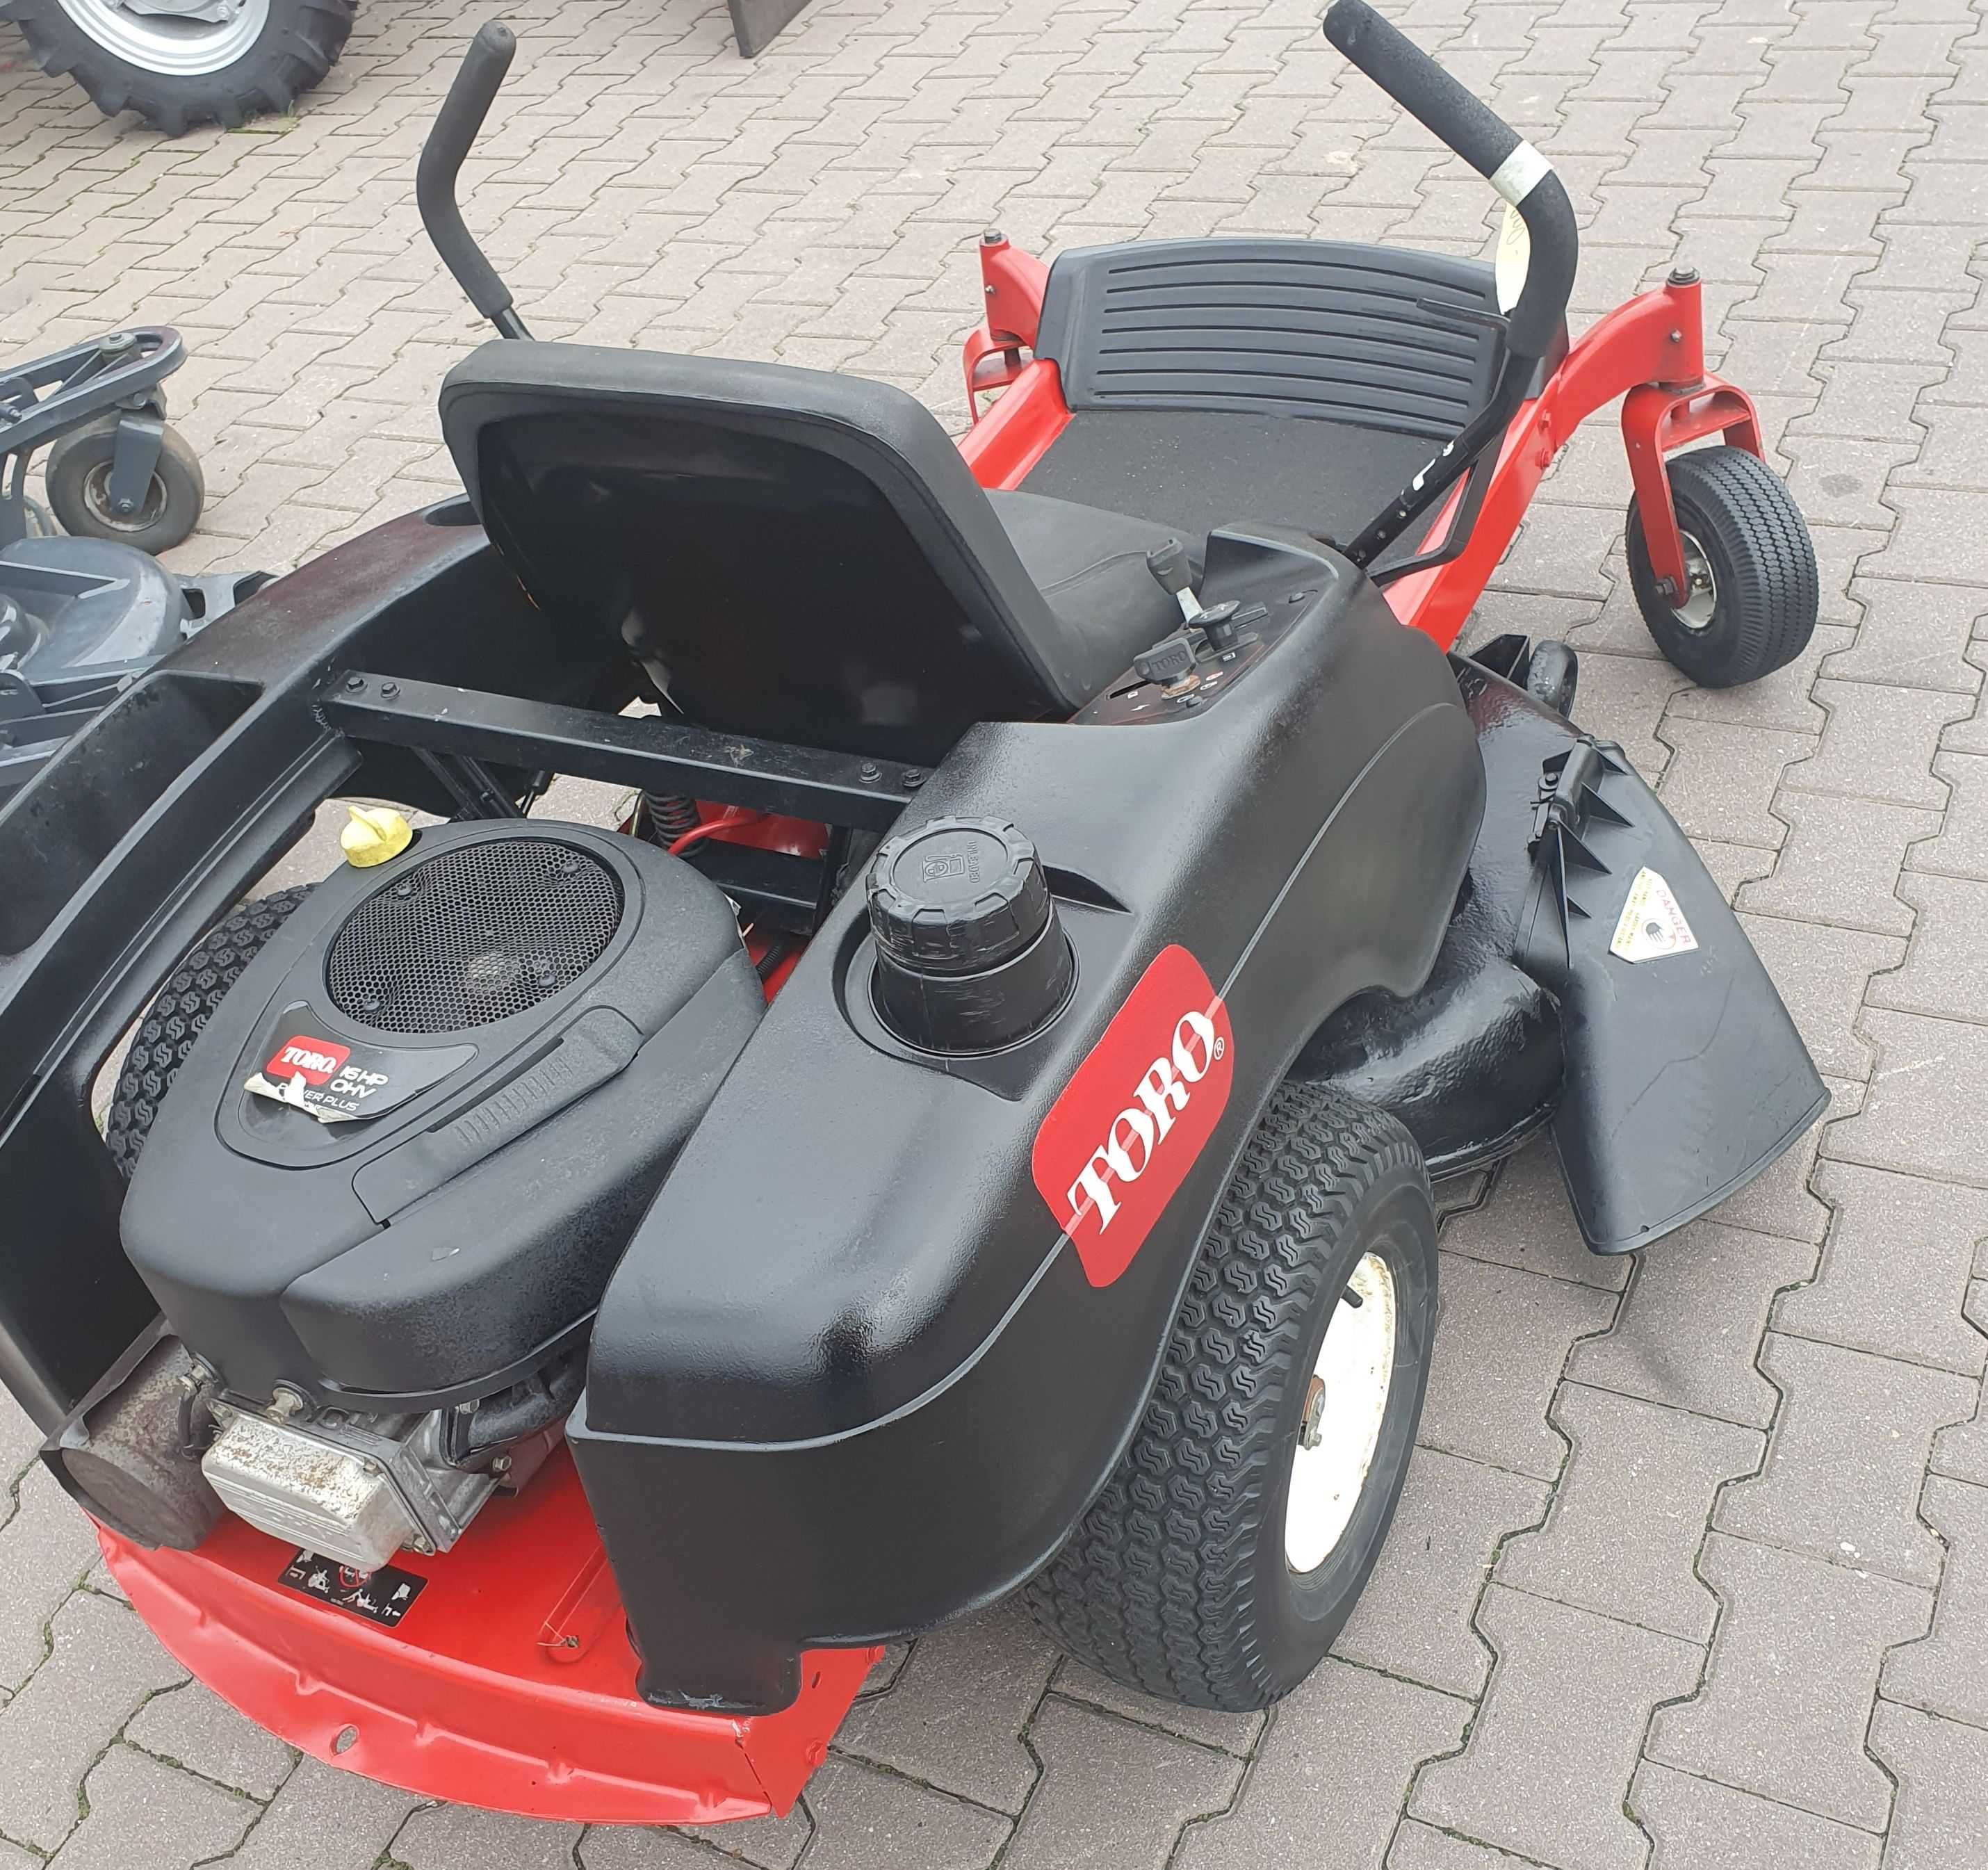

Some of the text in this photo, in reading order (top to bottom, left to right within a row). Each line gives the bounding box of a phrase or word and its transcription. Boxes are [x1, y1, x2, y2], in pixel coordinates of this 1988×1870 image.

[1152, 651, 1185, 672] TORO
[1656, 888, 1691, 944] DANGER
[280, 1046, 337, 1073] TORO
[330, 1079, 377, 1098] OHV
[339, 1066, 389, 1086] 16 HP
[277, 1082, 325, 1103] PER
[323, 1095, 360, 1112] PLUS
[1067, 1011, 1214, 1235] TORO
